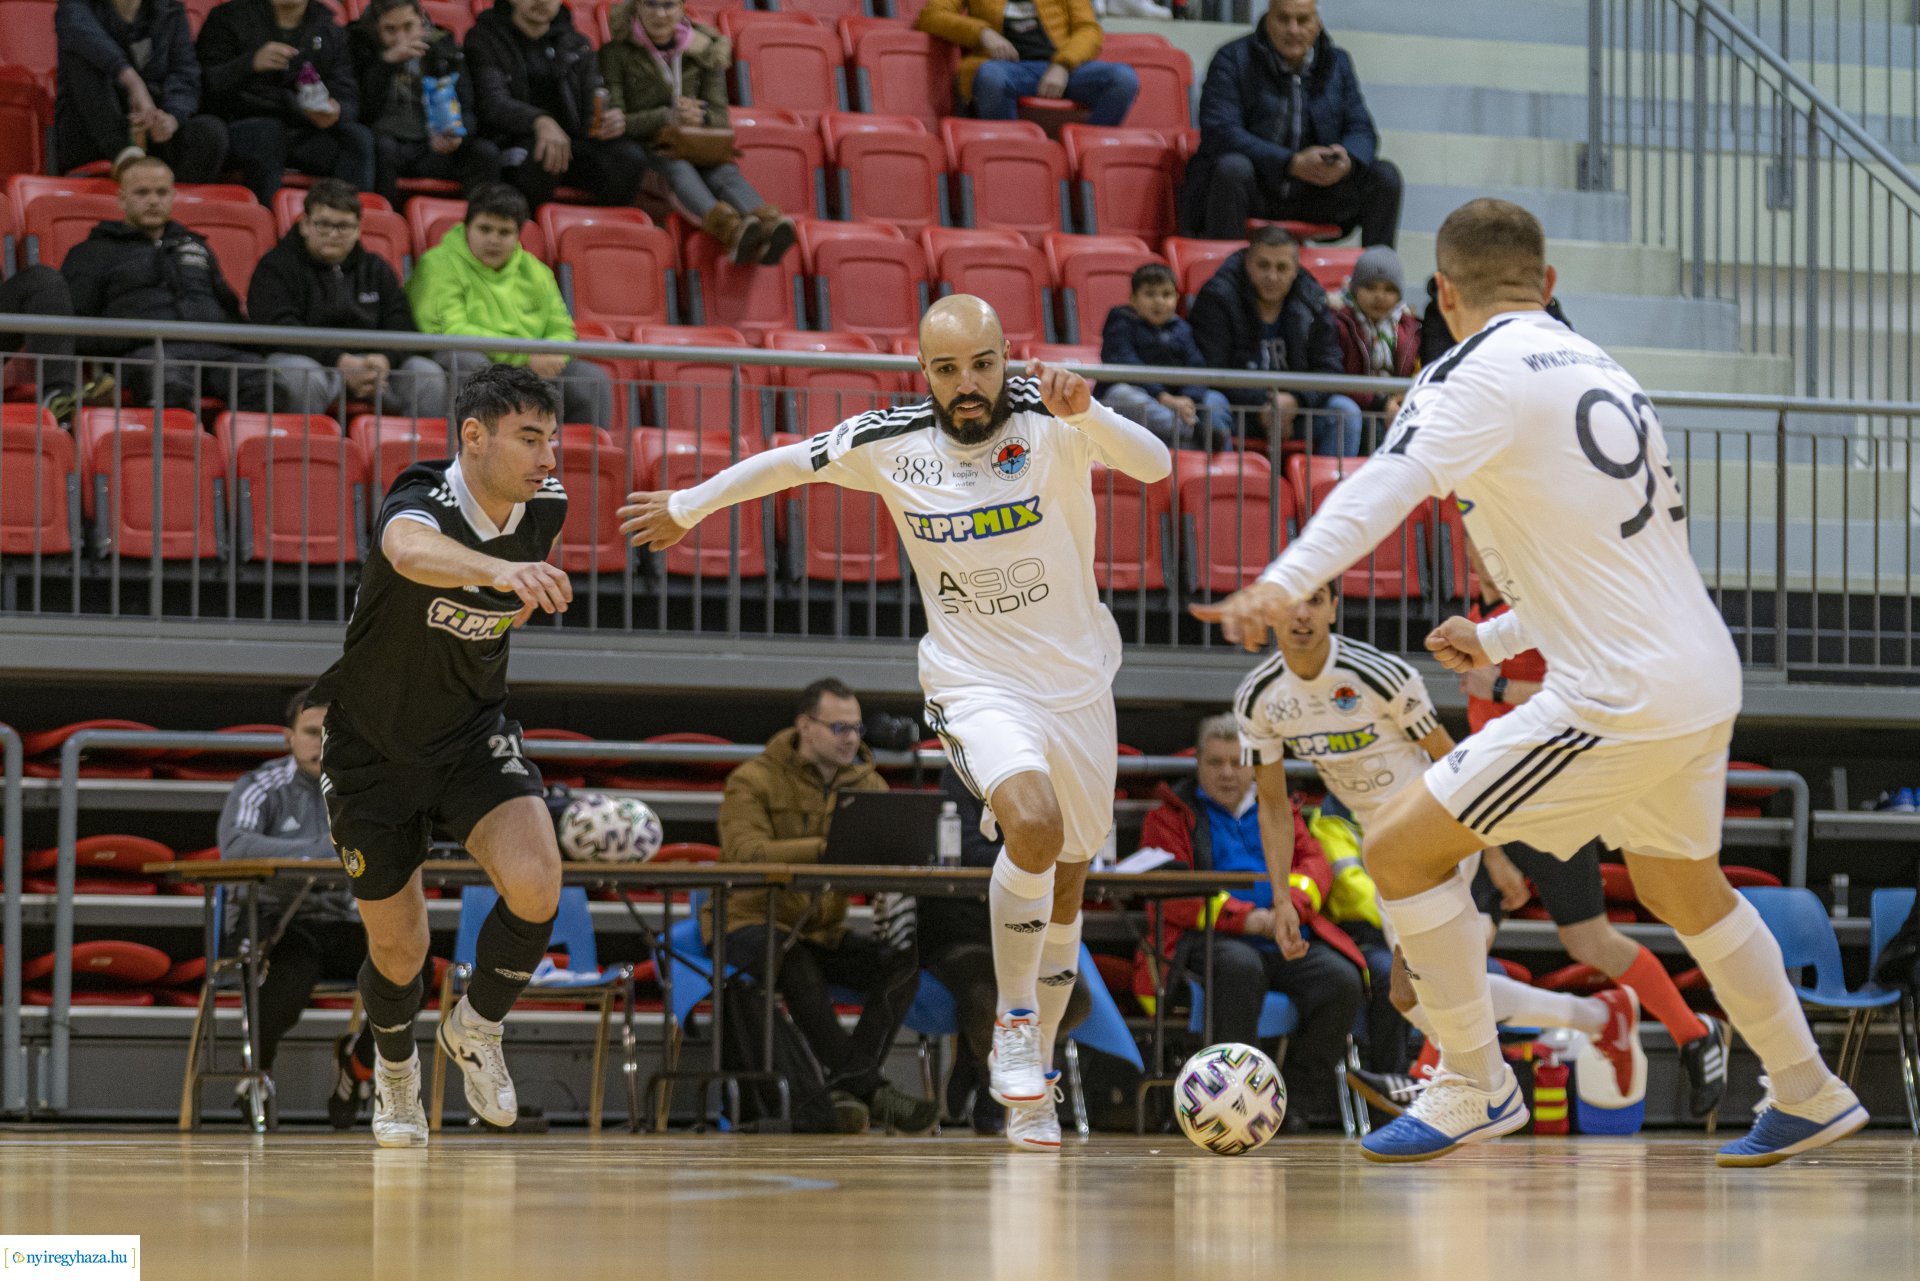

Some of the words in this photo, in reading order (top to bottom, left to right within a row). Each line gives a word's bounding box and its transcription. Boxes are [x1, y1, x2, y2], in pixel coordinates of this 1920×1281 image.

[892, 455, 943, 487] 383
[955, 480, 976, 488] water
[941, 583, 1049, 615] STUDIO
[1265, 697, 1302, 724] 383
[488, 733, 523, 759] 21
